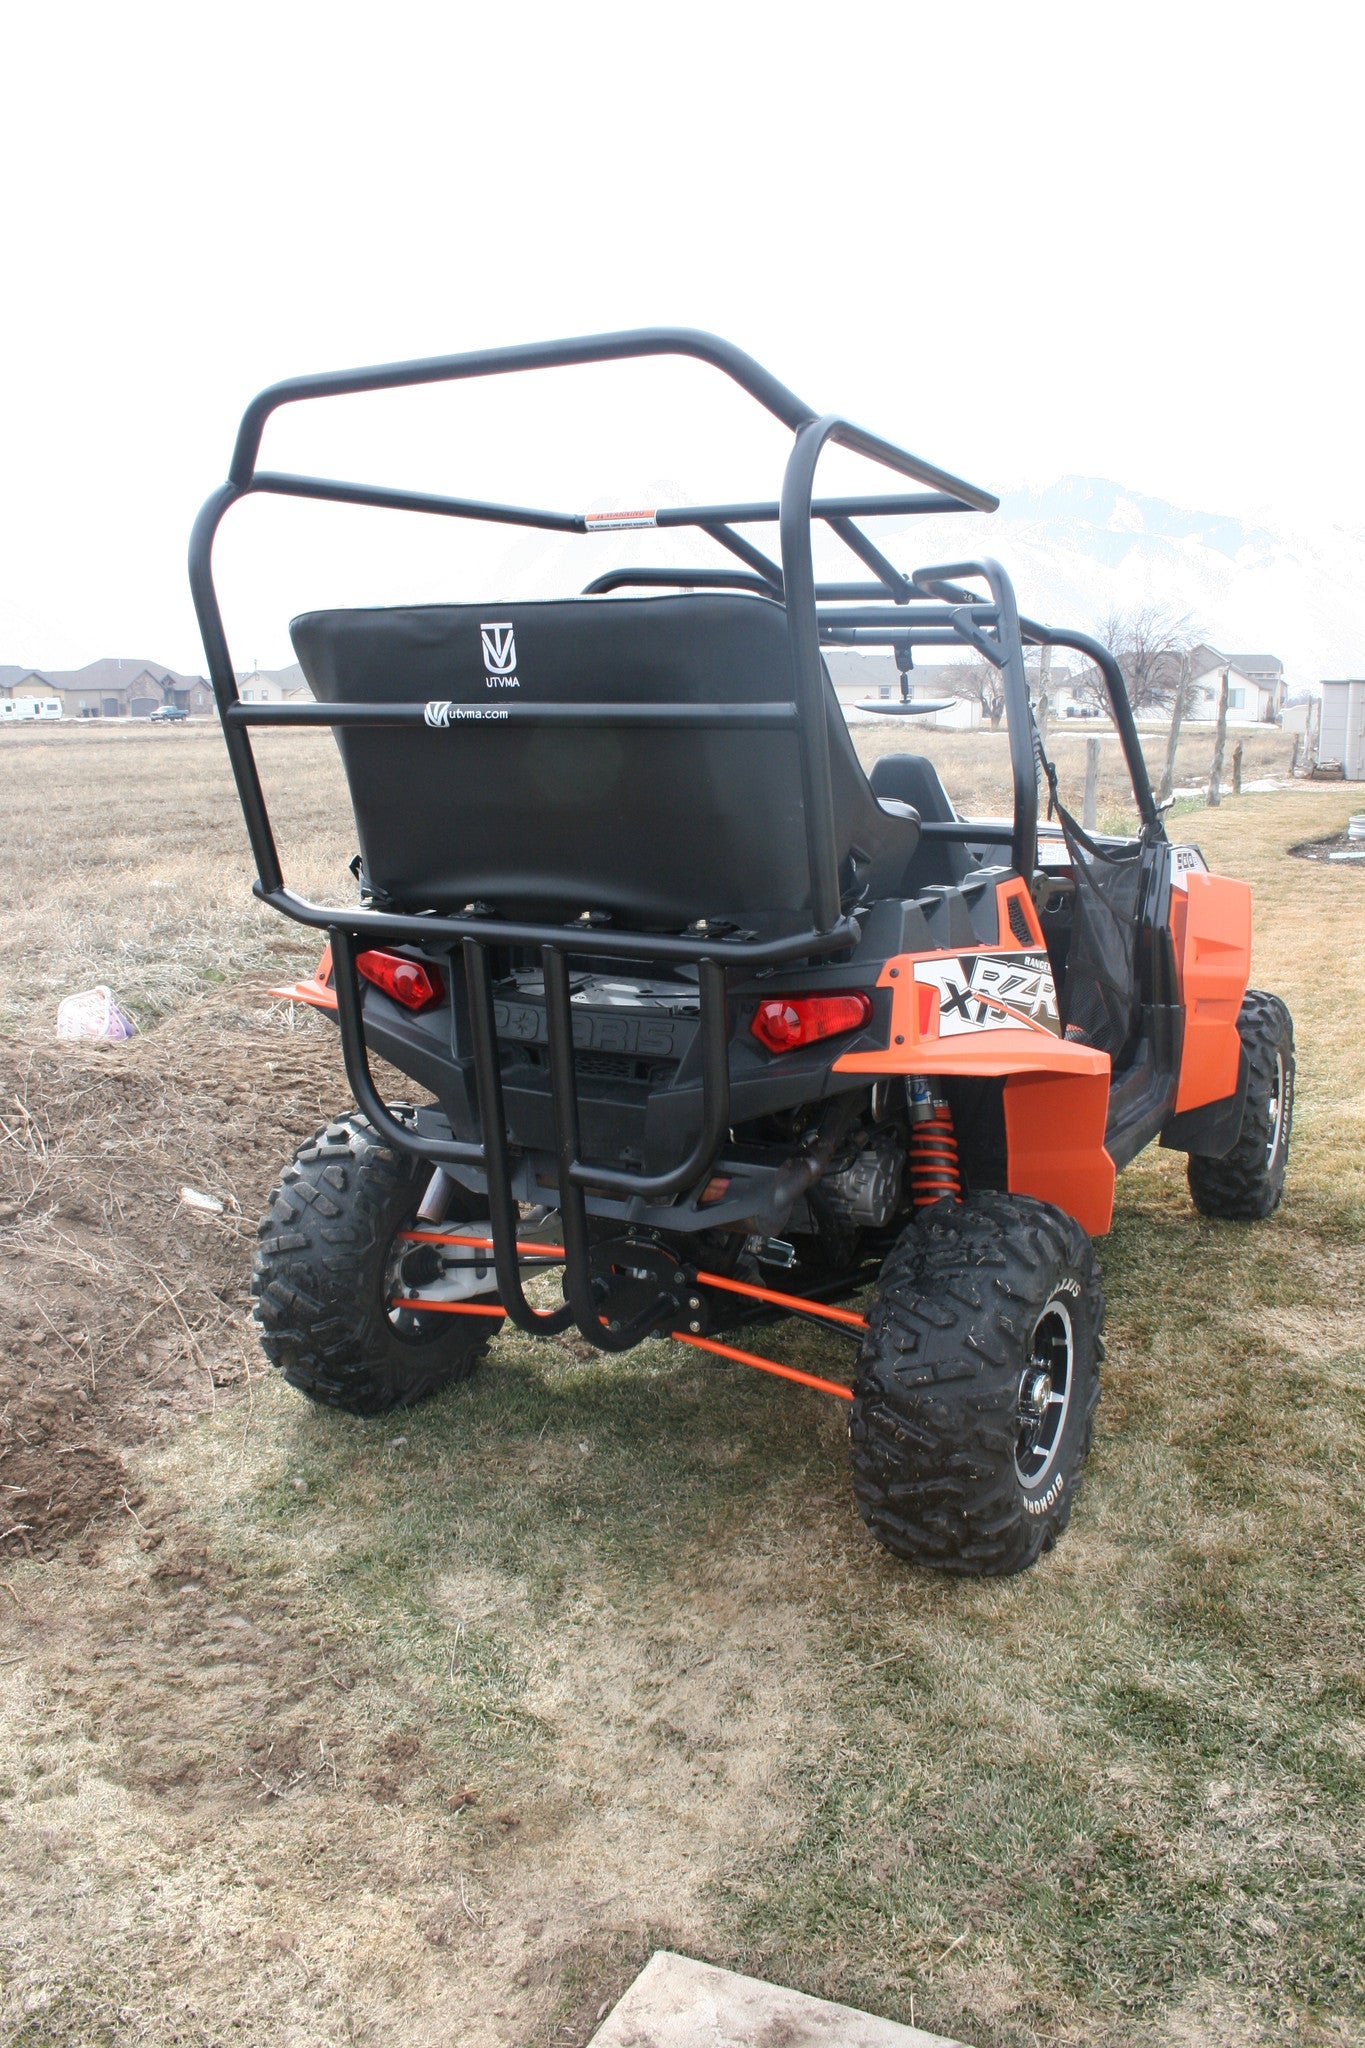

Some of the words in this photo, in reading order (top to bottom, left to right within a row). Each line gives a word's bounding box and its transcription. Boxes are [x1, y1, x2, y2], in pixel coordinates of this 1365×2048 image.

[486, 677, 520, 688] UTVMA
[449, 709, 508, 719] utvma.com
[970, 956, 1060, 1019] RZR
[494, 1003, 675, 1056] POARIS
[1281, 1070, 1291, 1146] BIGHORN
[1023, 1472, 1064, 1515] BIGHORN
